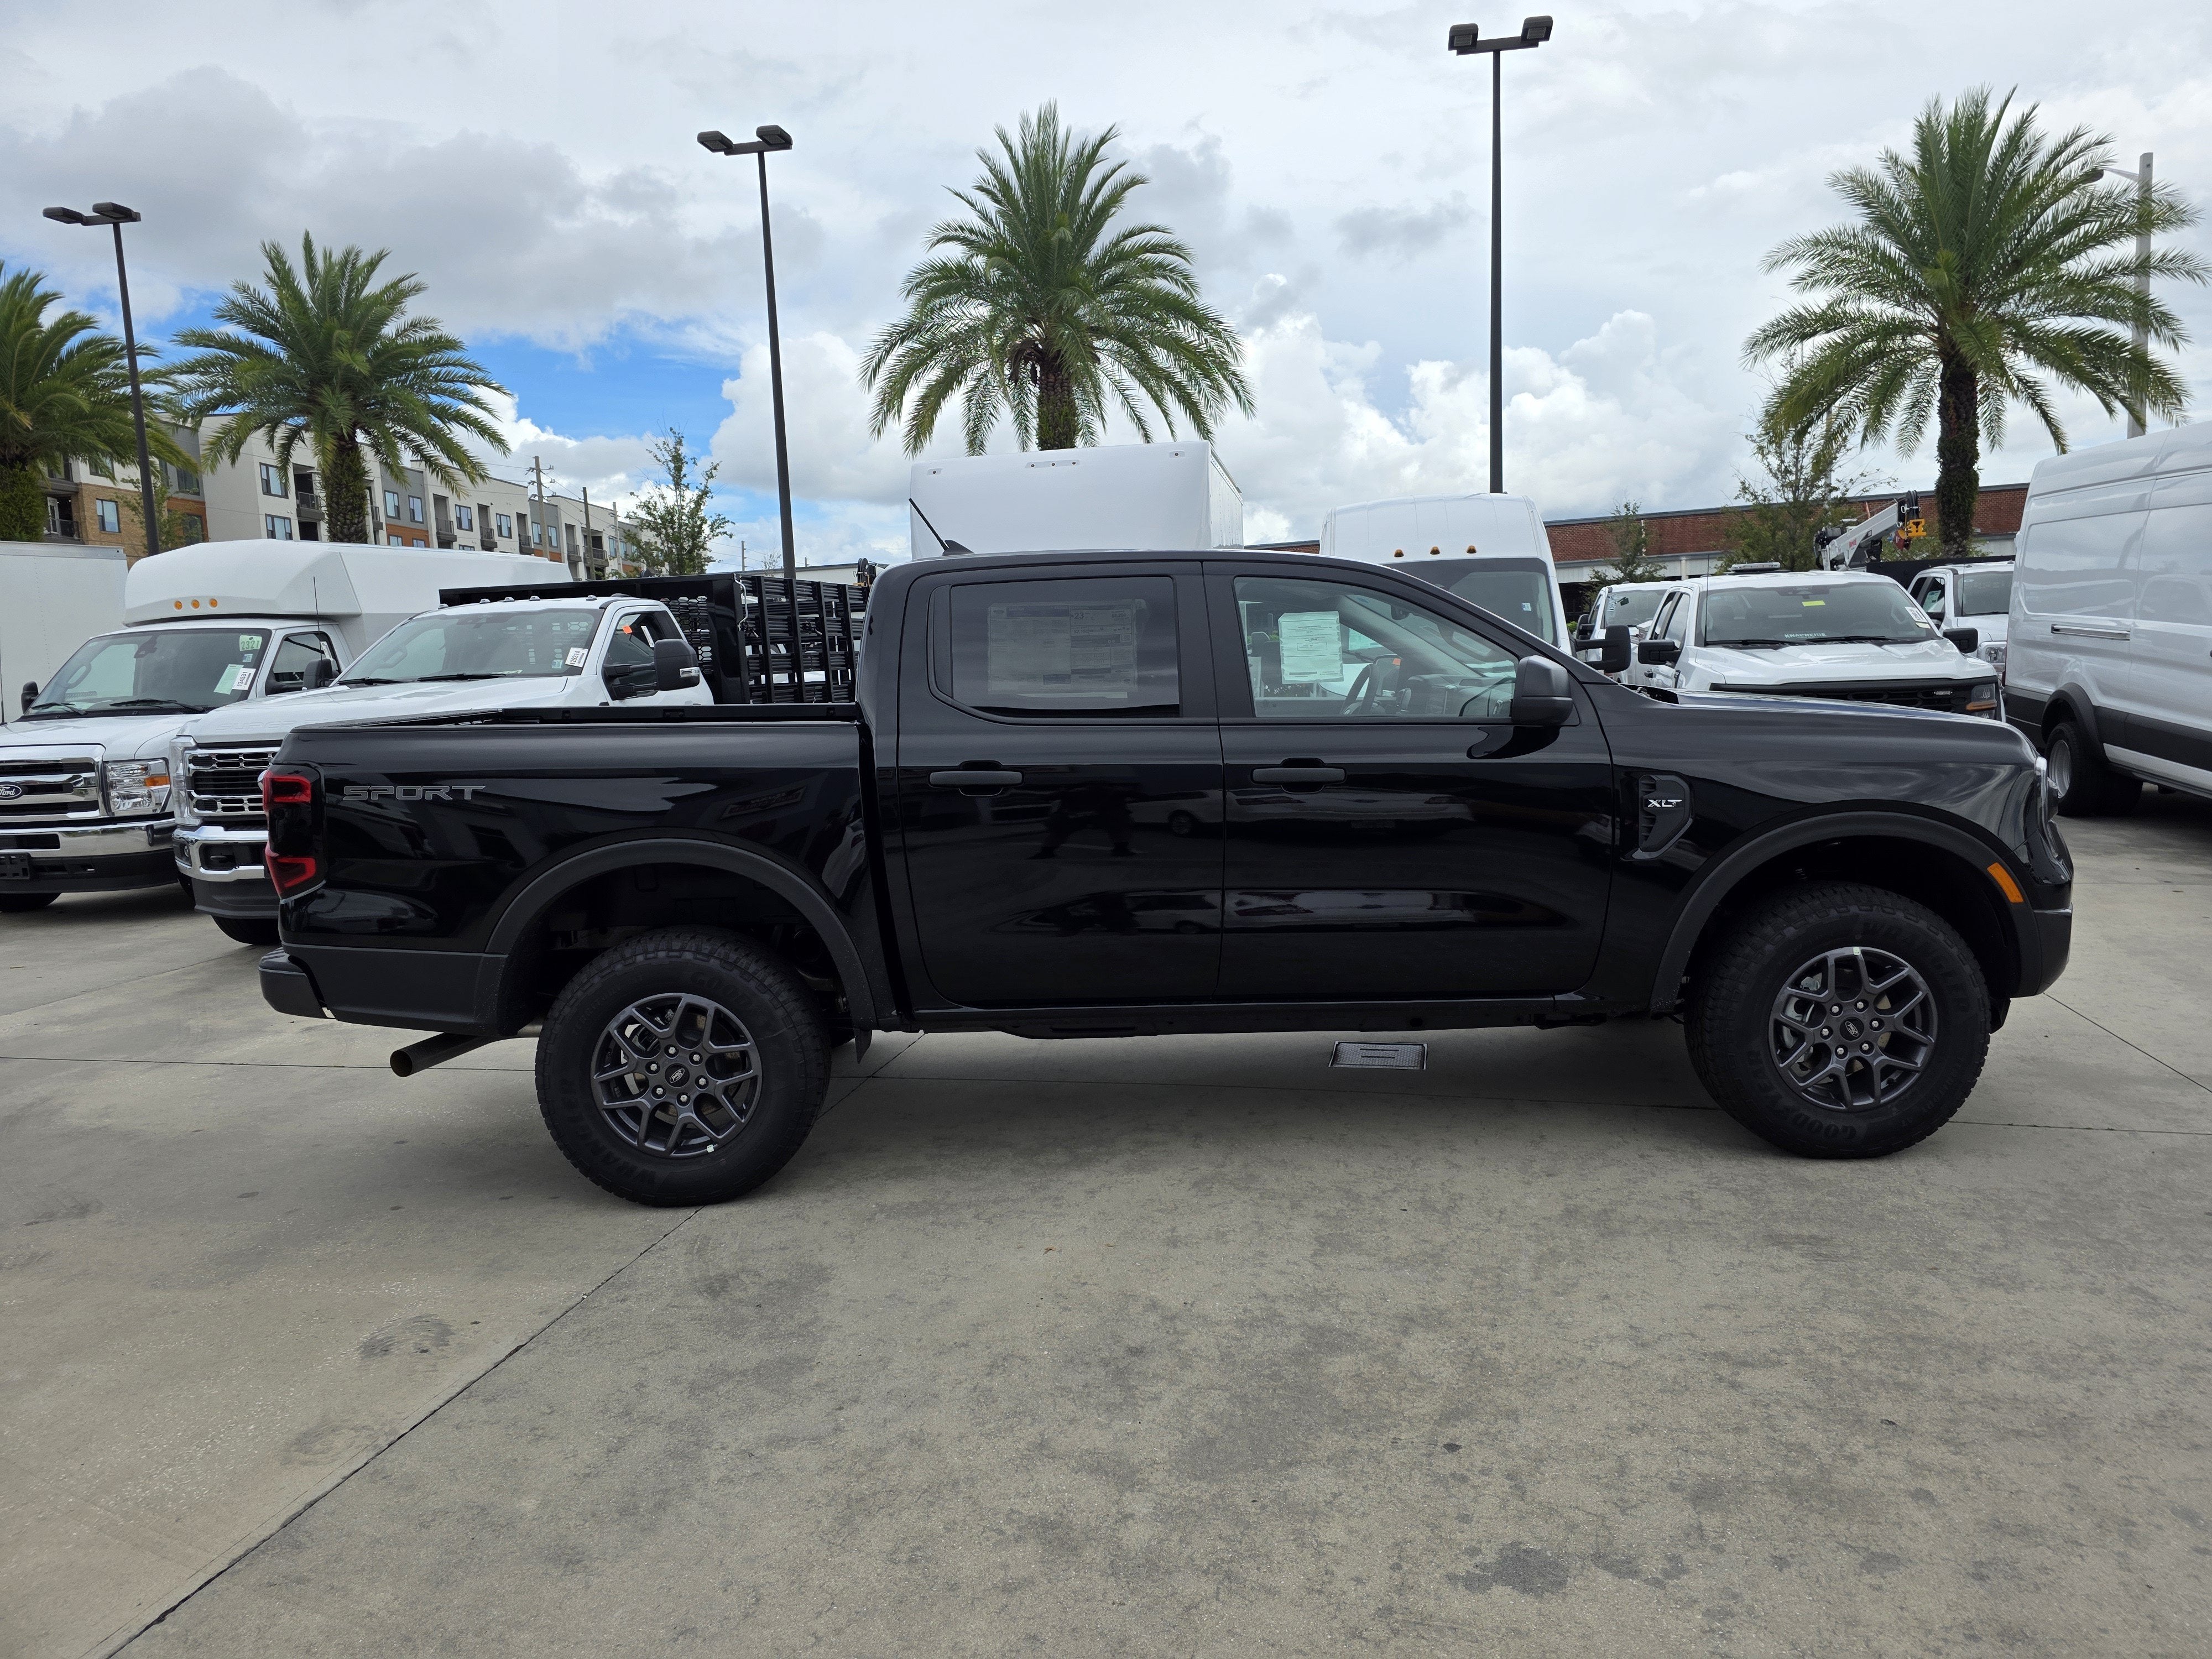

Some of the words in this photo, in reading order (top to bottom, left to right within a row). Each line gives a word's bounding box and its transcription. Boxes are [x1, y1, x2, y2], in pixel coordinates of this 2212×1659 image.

[342, 786, 486, 800] SPORT
[1647, 799, 1682, 807] XLT
[671, 1070, 683, 1082] Ford
